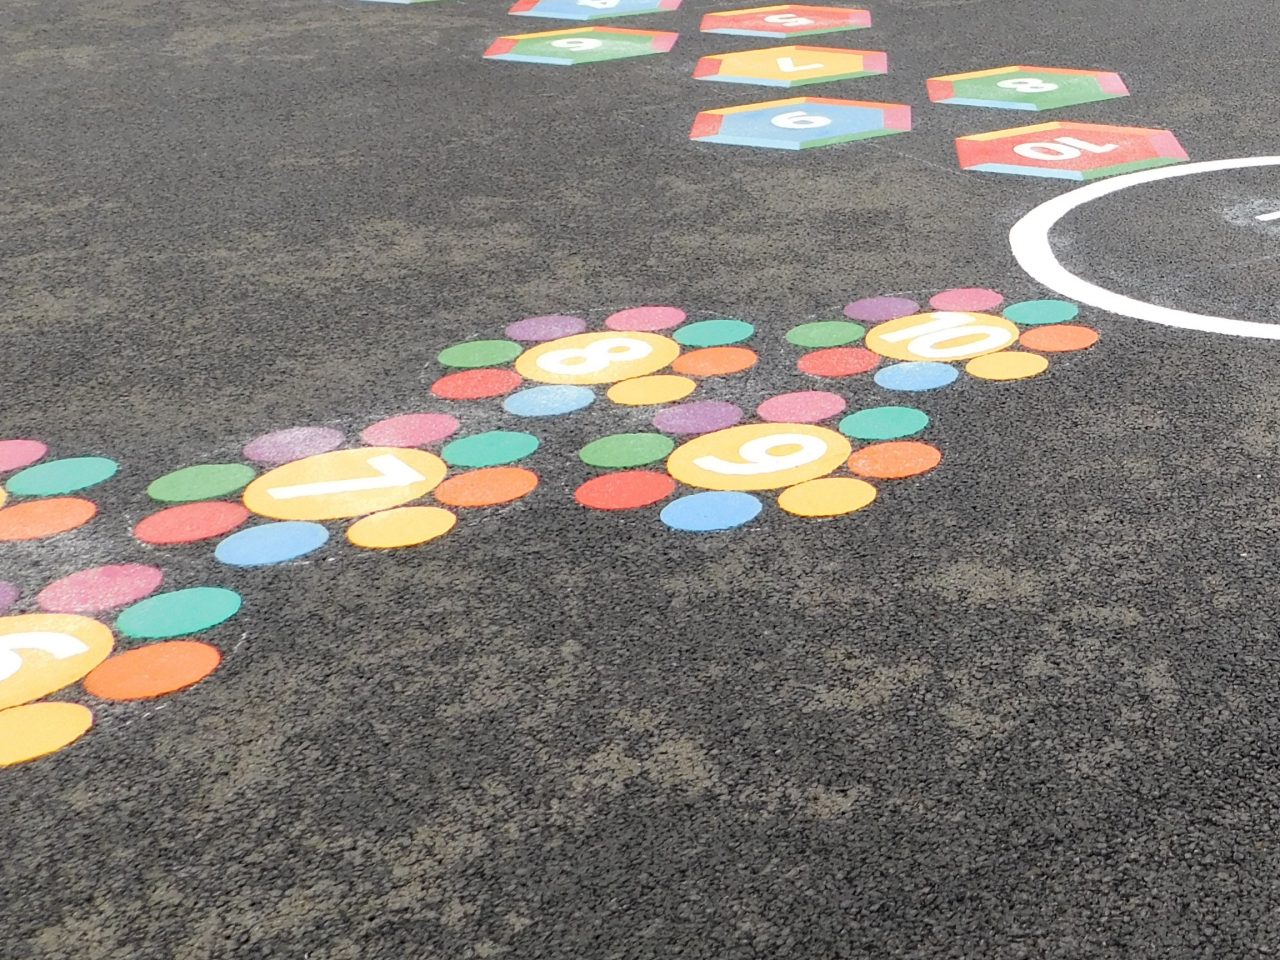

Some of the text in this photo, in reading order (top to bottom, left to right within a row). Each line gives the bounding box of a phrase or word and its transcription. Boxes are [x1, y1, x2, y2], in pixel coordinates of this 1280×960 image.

[765, 14, 814, 26] 5
[776, 57, 824, 73] 7
[995, 77, 1058, 93] 8
[1014, 137, 1118, 161] 10
[880, 311, 1012, 358] 10
[537, 337, 652, 376] 8
[267, 454, 426, 500] 7
